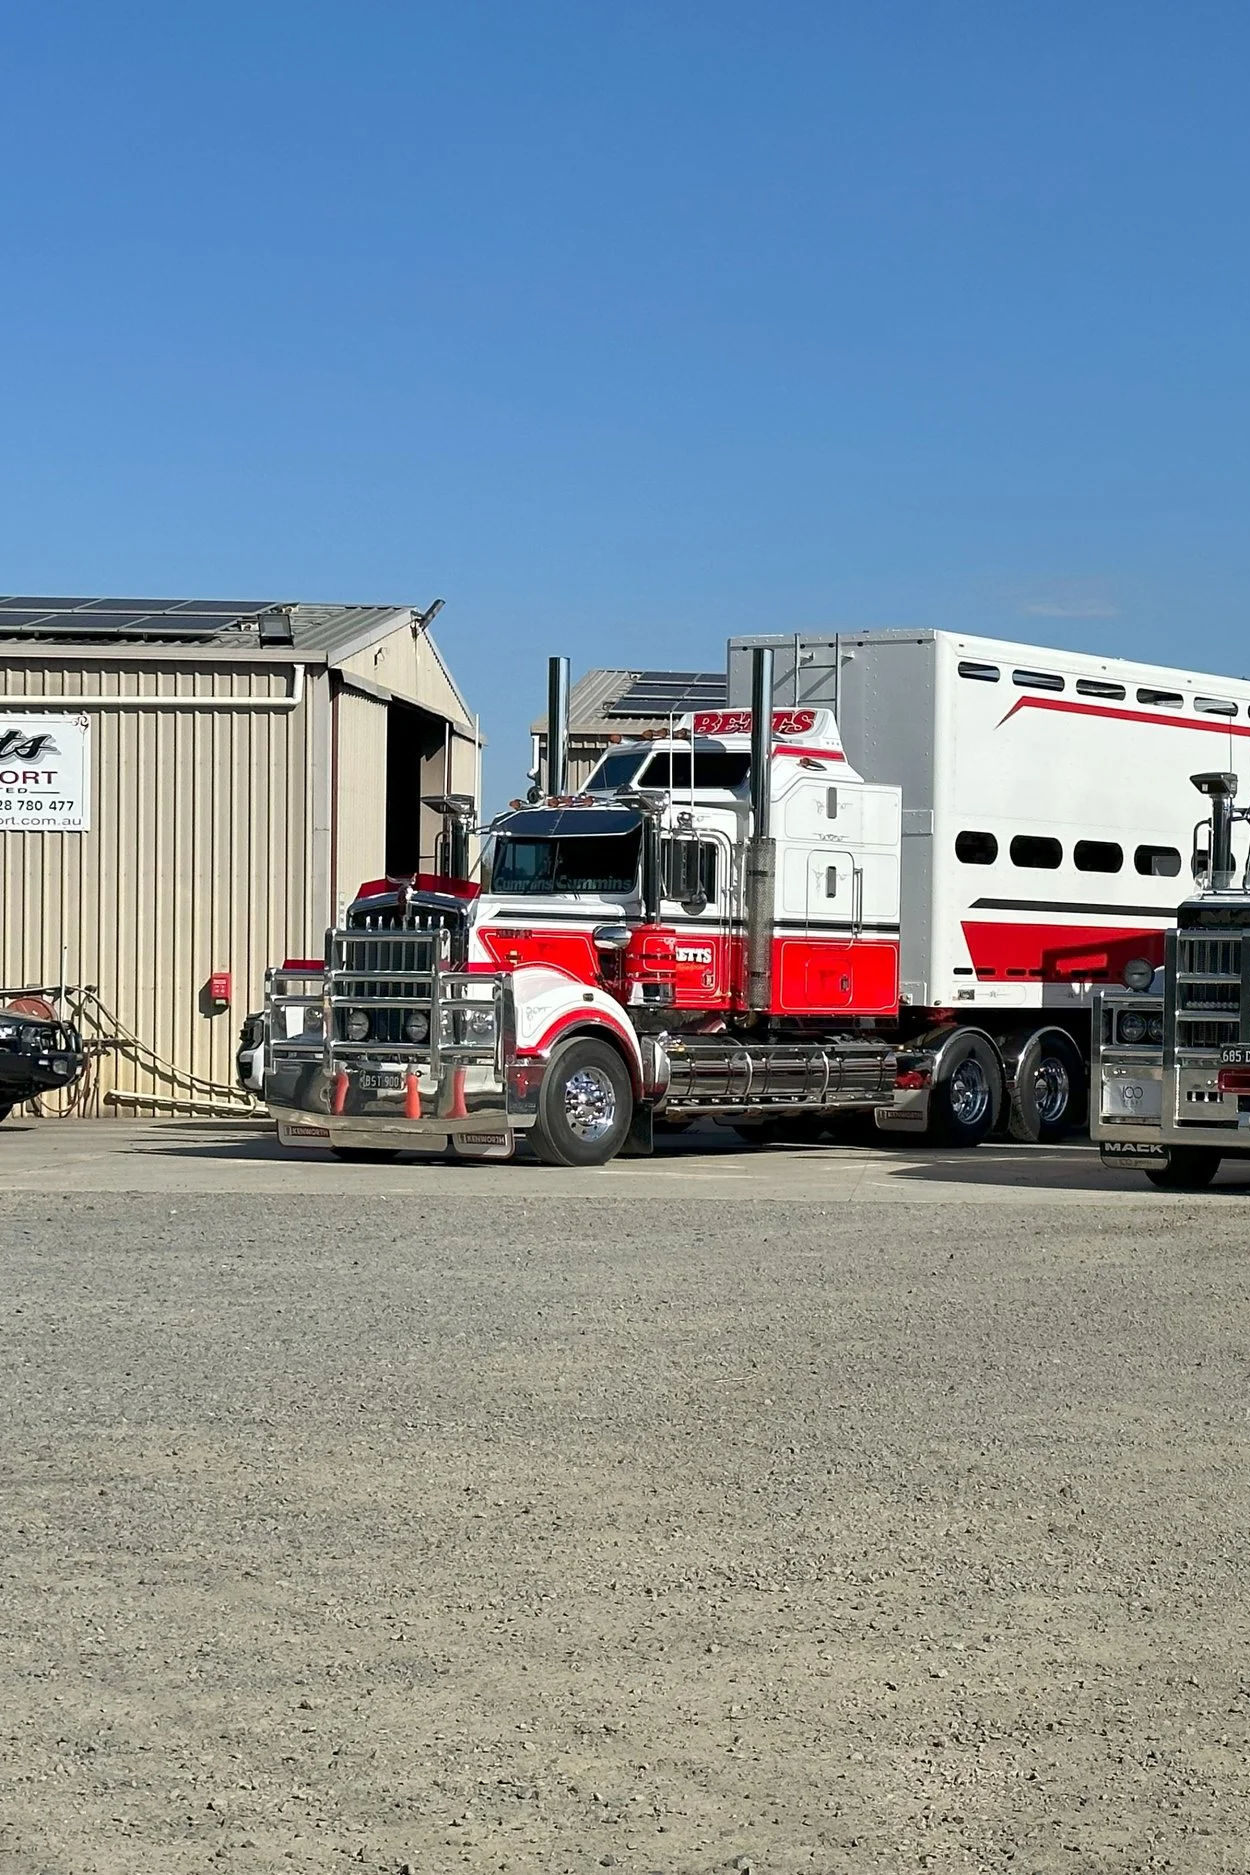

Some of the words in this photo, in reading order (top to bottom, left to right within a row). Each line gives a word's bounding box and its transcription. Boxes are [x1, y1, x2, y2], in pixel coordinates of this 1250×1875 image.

[17, 801, 43, 811] 780
[48, 801, 74, 811] 477
[555, 874, 633, 891] Cummins
[1222, 1050, 1242, 1063] 685
[364, 1077, 382, 1088] BST
[384, 1077, 400, 1087] 900
[291, 1126, 329, 1137] KENWORTH
[467, 1133, 505, 1145] KENWORTH
[1104, 1142, 1164, 1154] MACK
